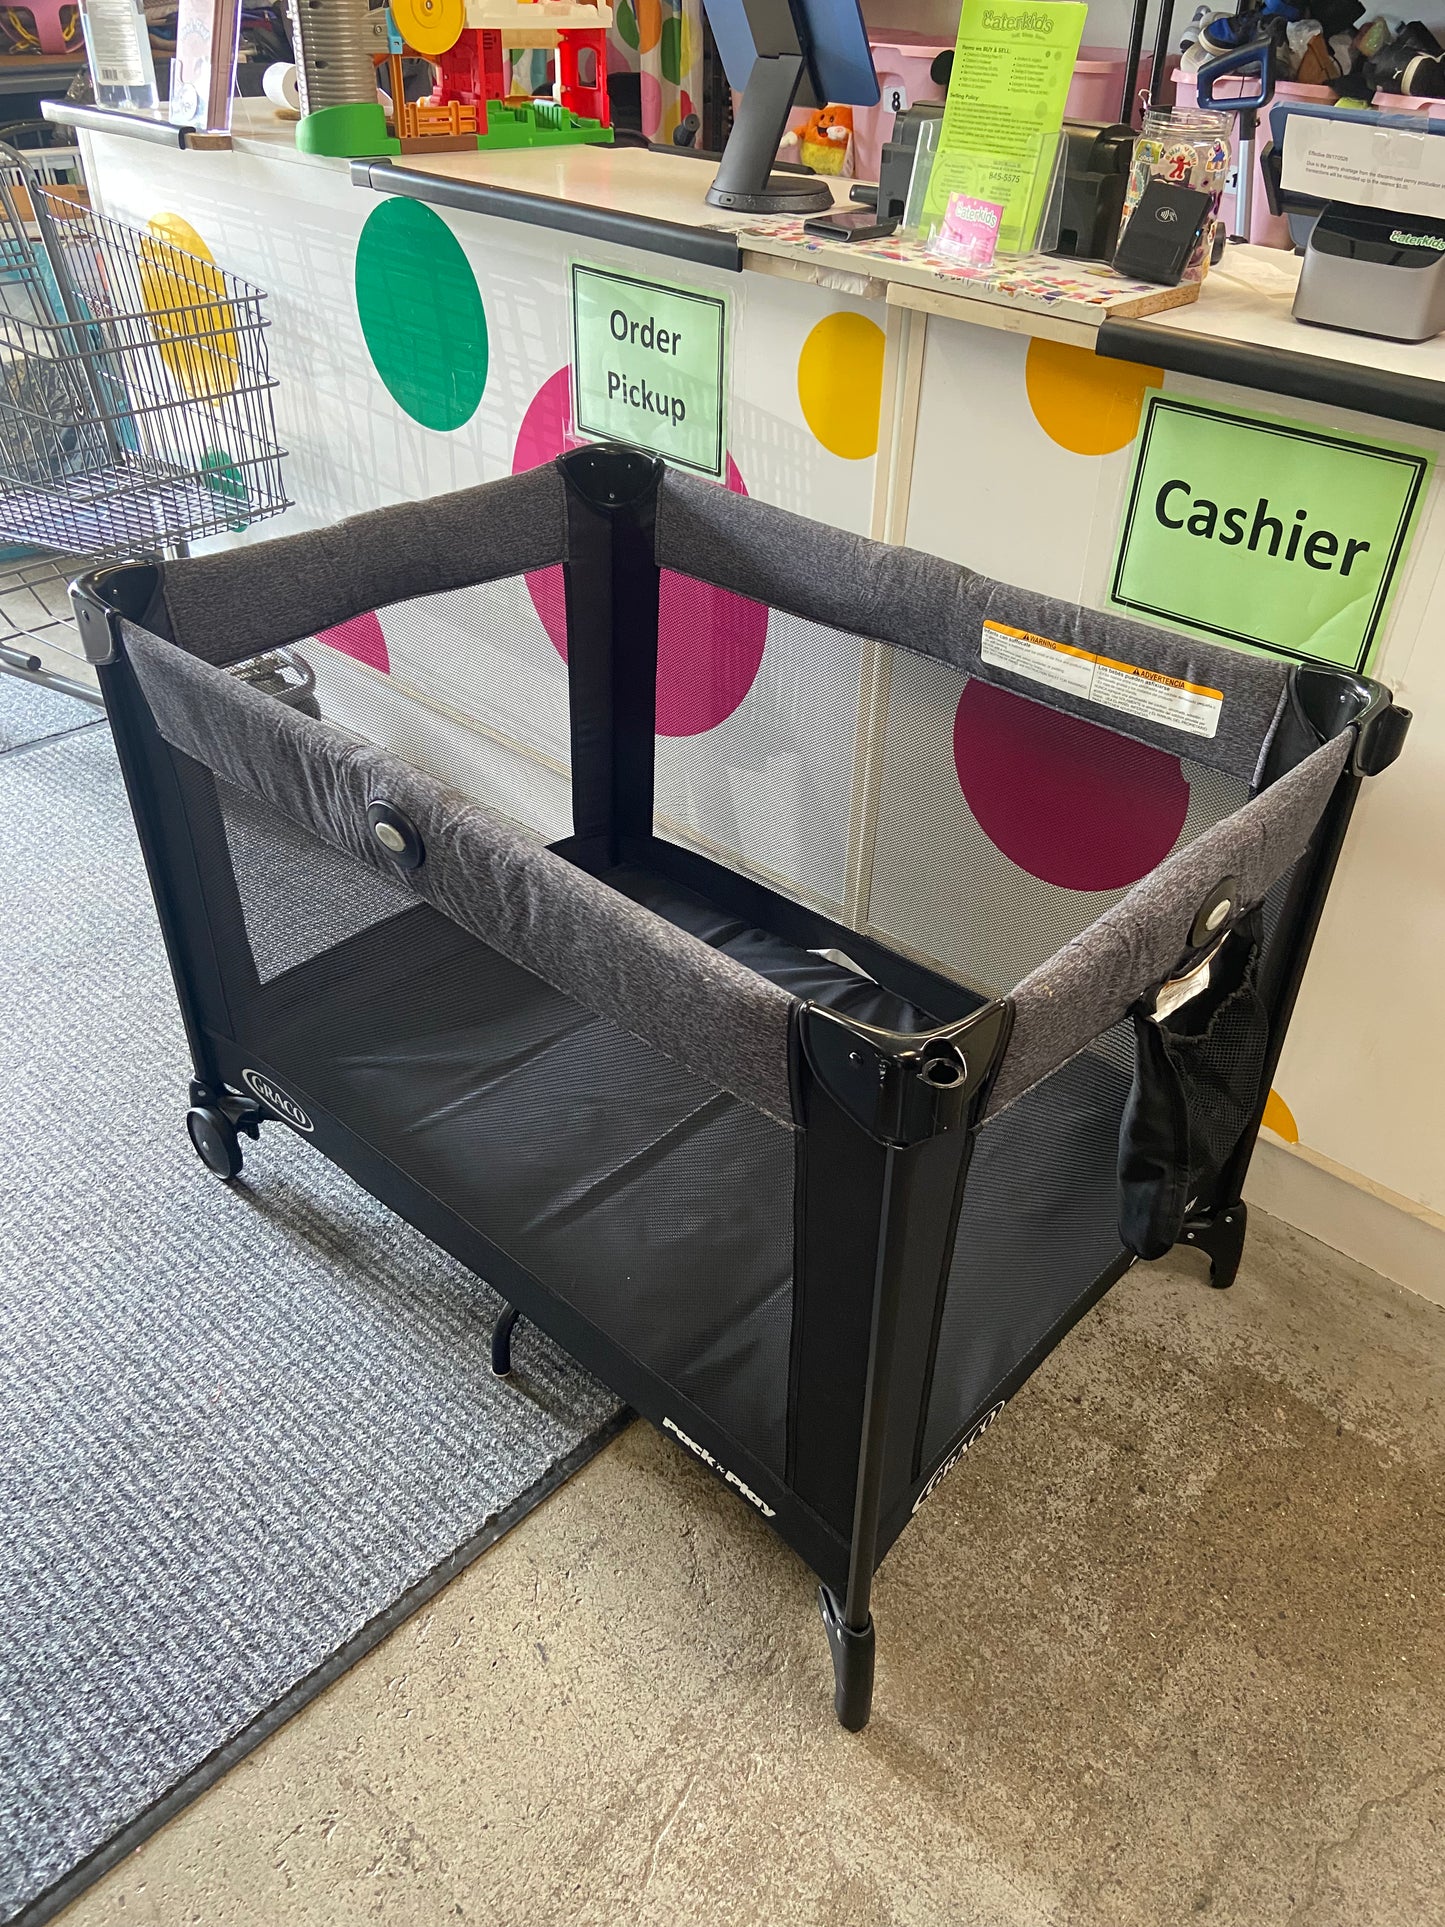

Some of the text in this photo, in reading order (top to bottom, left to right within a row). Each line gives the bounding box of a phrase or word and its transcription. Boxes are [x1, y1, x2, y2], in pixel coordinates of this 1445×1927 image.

[892, 92, 900, 111] 8
[989, 172, 1020, 183] 845-5575
[610, 310, 681, 355] Order
[608, 371, 686, 426] Pickup
[1154, 479, 1370, 577] Cashier
[984, 629, 999, 638] Infants
[1008, 637, 1031, 648] suffocate
[1030, 635, 1056, 649] WARNING
[1124, 673, 1144, 684] pueden
[1145, 679, 1170, 691] asfixiarse
[1141, 671, 1185, 688] ADVERTENCIA
[252, 1075, 306, 1124] GRACO
[662, 1416, 716, 1467] Pack
[725, 1470, 776, 1517] Play
